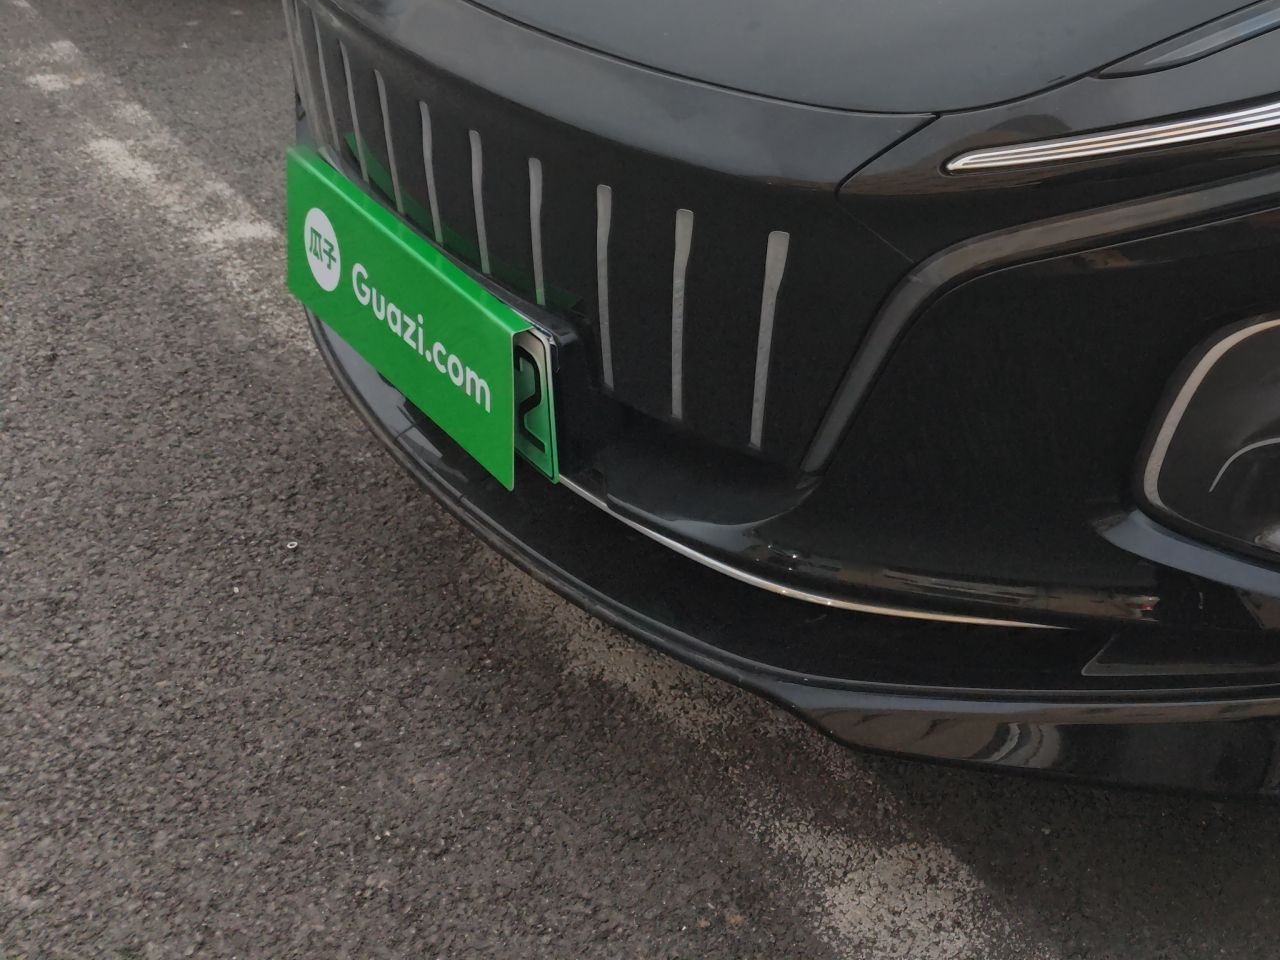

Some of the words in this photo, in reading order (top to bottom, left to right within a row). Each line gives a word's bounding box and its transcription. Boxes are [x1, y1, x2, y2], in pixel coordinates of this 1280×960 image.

[309, 226, 337, 271] 瓜子
[352, 262, 491, 413] Guazi.com
[513, 345, 546, 455] 2
